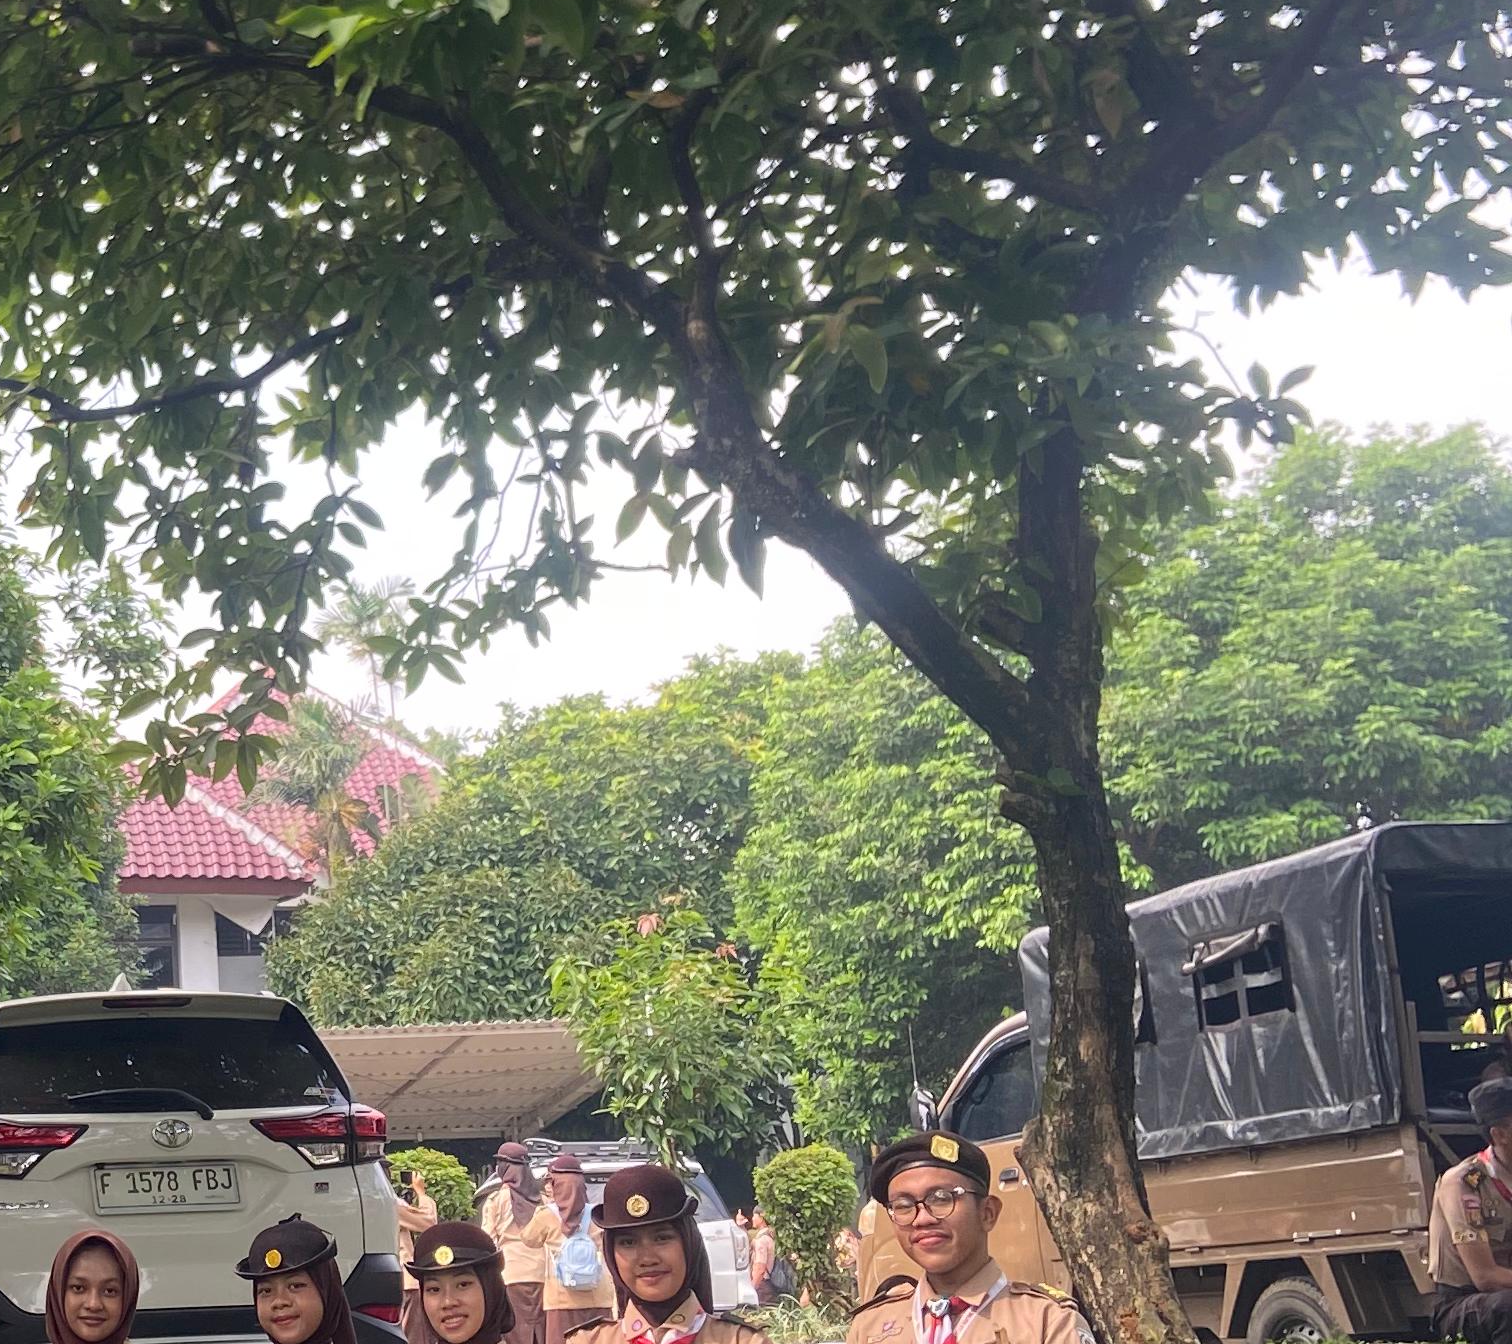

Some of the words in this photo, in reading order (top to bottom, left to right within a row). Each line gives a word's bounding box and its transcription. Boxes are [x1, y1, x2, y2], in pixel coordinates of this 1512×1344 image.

[100, 1173, 111, 1194] F
[125, 1171, 179, 1193] 1578
[192, 1168, 233, 1191] FBJ
